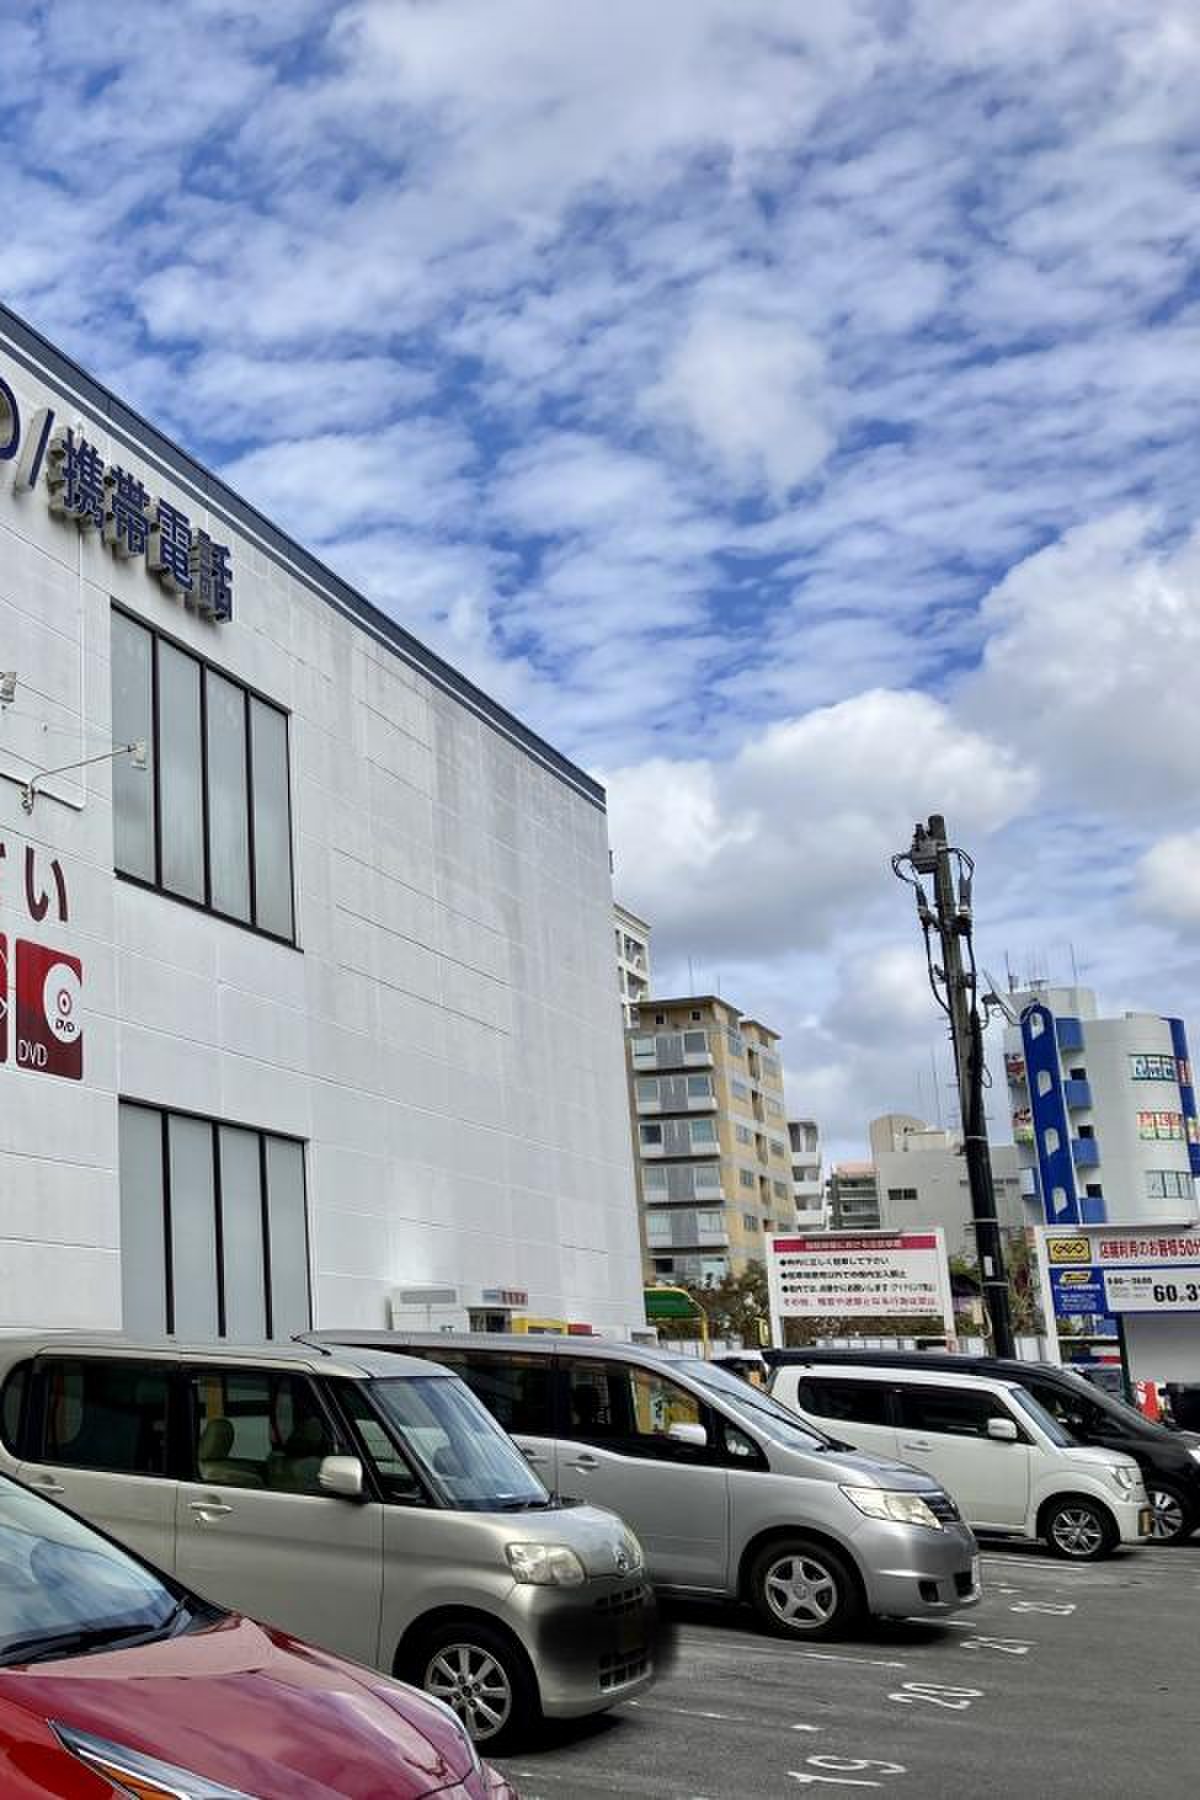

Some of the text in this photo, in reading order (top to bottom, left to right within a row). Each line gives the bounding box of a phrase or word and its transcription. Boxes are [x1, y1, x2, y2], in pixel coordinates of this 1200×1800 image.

[18, 1039, 48, 1068] DVD
[887, 1682, 984, 1710] 20
[786, 1754, 907, 1787] 19
